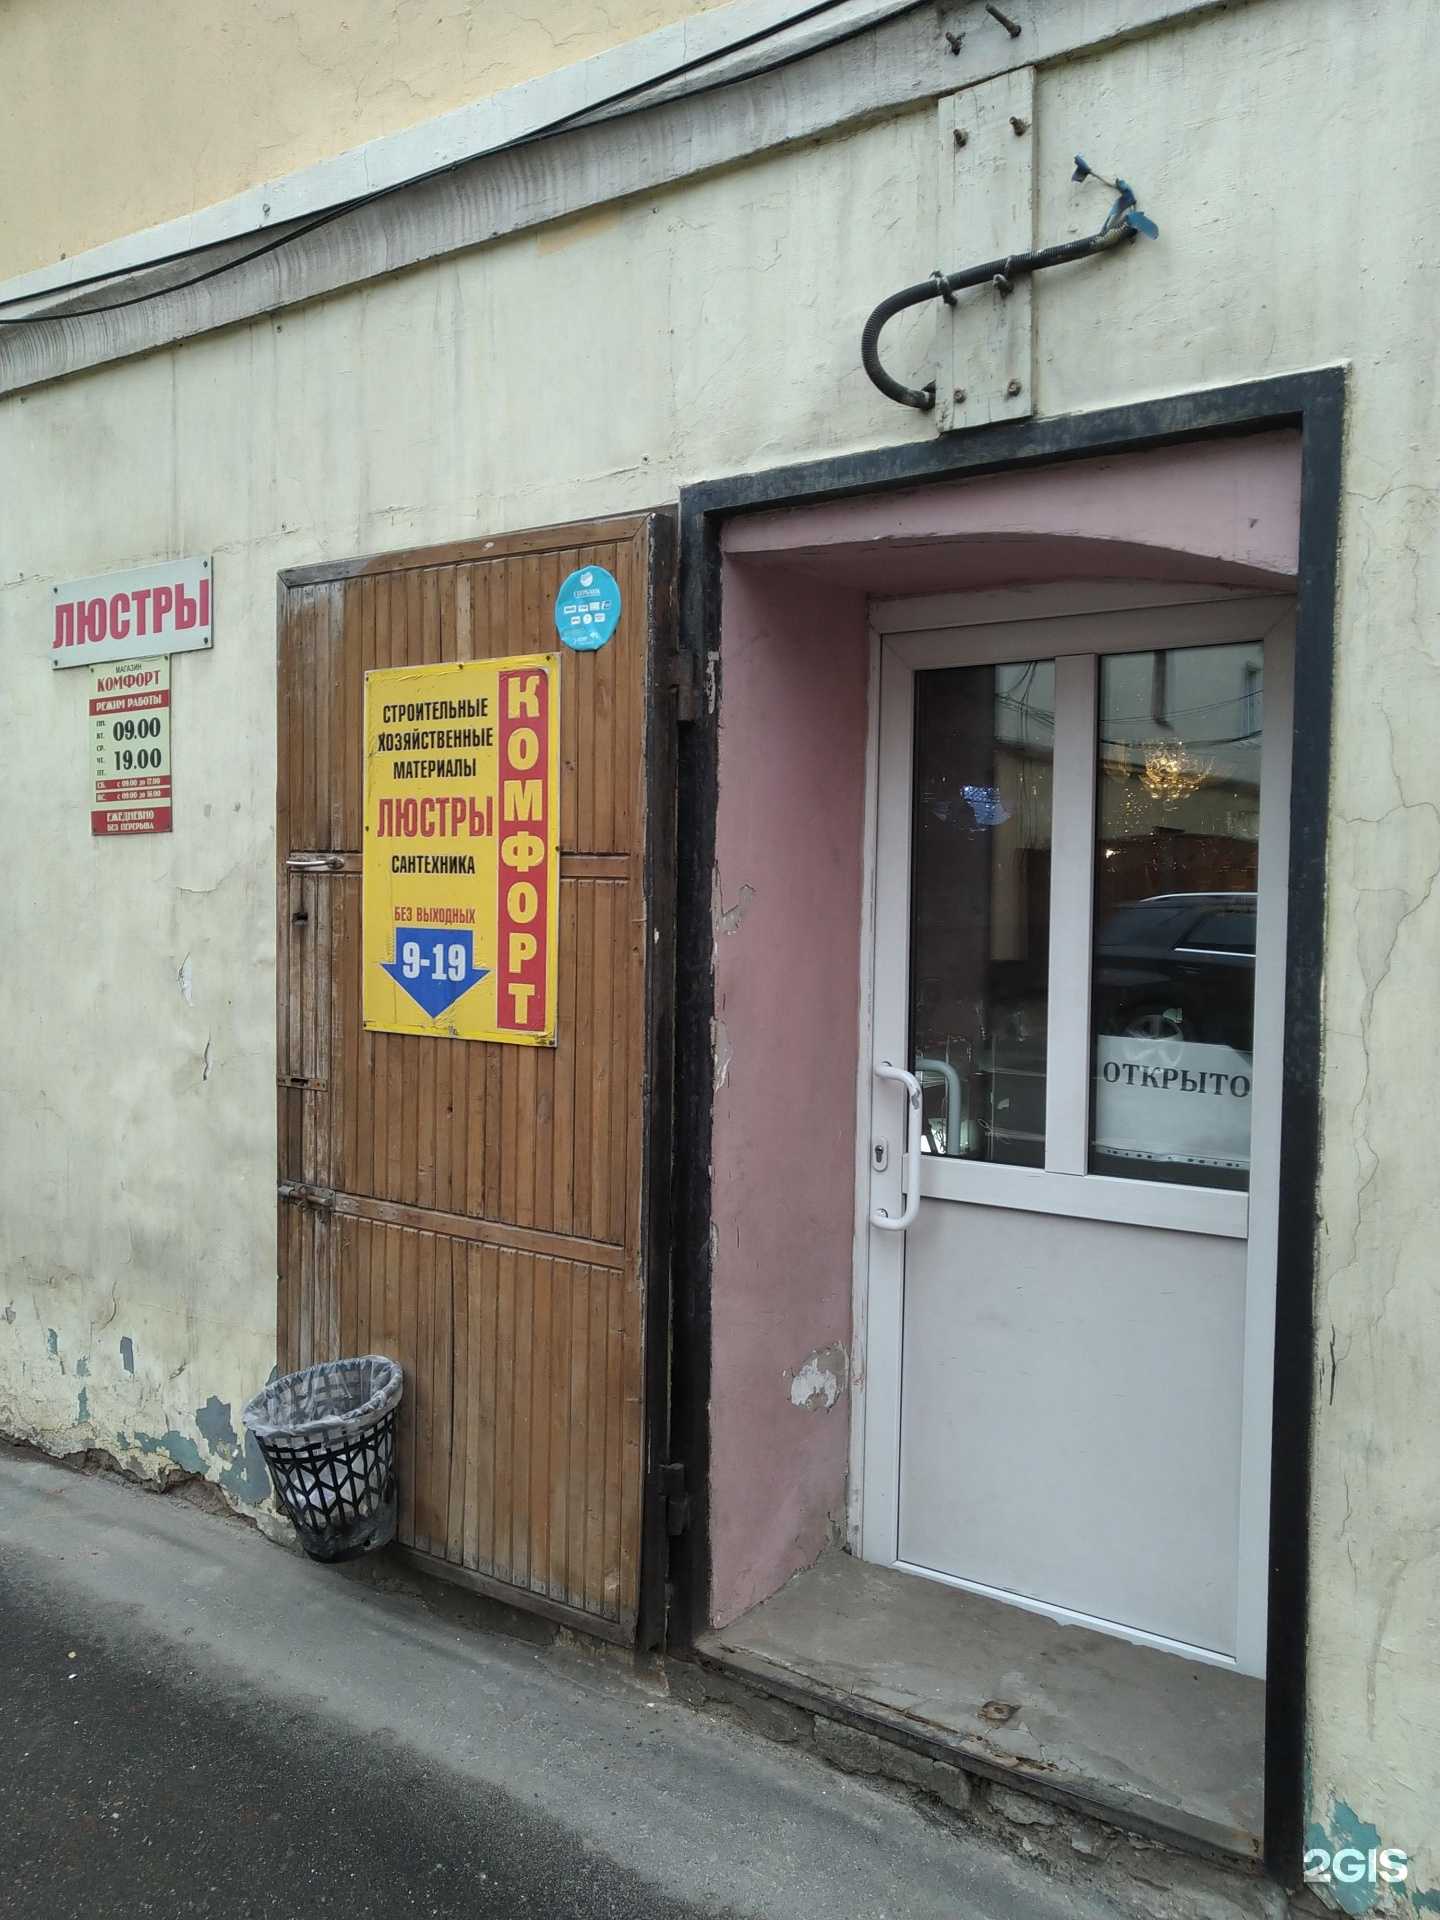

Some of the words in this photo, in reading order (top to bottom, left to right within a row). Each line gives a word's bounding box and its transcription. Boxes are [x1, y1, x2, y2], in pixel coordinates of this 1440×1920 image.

[52, 578, 210, 649] ЛЮСТРЫ
[115, 664, 142, 673] МАГАЗИН
[97, 670, 160, 692] КОМФОРТ
[96, 699, 126, 711] РЕЖИМ
[127, 694, 162, 707] РАБОТЫ
[383, 698, 488, 723] СТРОИТЕЛЬНЫЕ
[113, 717, 161, 741] 09.00
[378, 728, 493, 752] ХОЗЯЙСТВЕННЫЕ
[114, 748, 162, 771] 19.00
[393, 758, 476, 779] МАТЕРИАЛЫ
[377, 796, 493, 838] ЛЮСТРЫ
[501, 675, 545, 1024] КОМФОРТ
[391, 855, 475, 874] САНТЕХНИКА
[394, 907, 412, 921] БЕЗ
[416, 907, 475, 925] ВЫХОДНЫХ
[402, 941, 466, 982] 9-19
[1103, 1061, 1250, 1098] ОТКРЫТО
